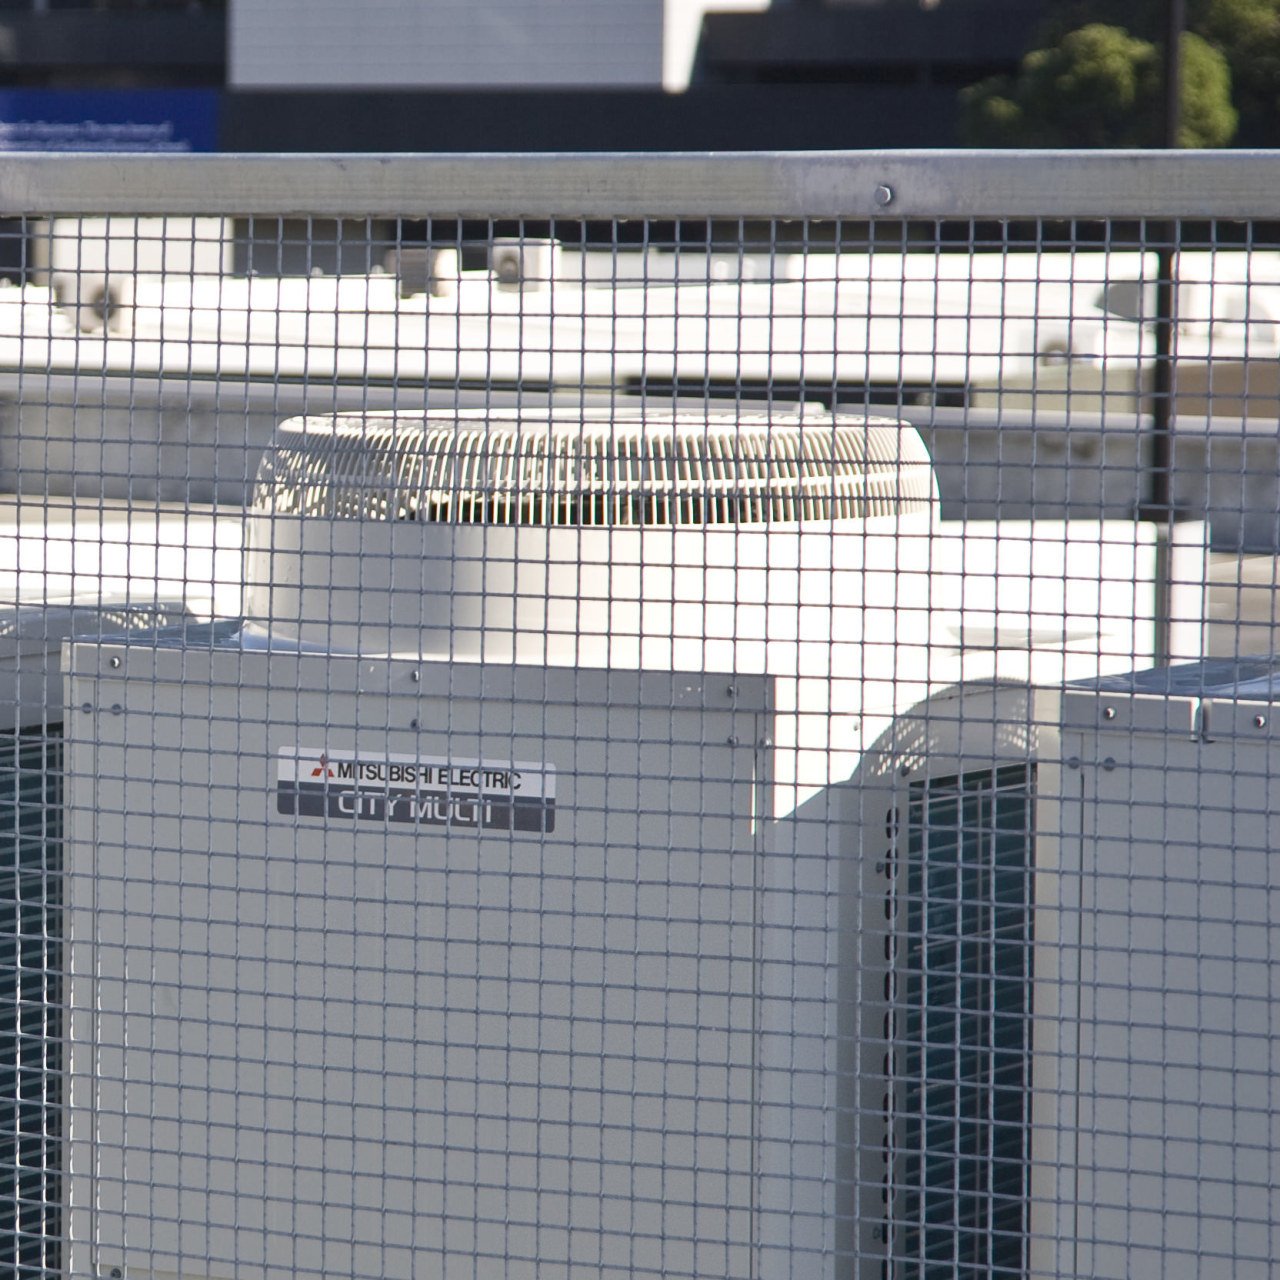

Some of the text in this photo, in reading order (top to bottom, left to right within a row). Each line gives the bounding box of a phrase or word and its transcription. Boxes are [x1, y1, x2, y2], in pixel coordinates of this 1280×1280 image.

[337, 762, 522, 790] MITSUBISHI ELECTRIC
[338, 790, 492, 823] CITY MULTI
